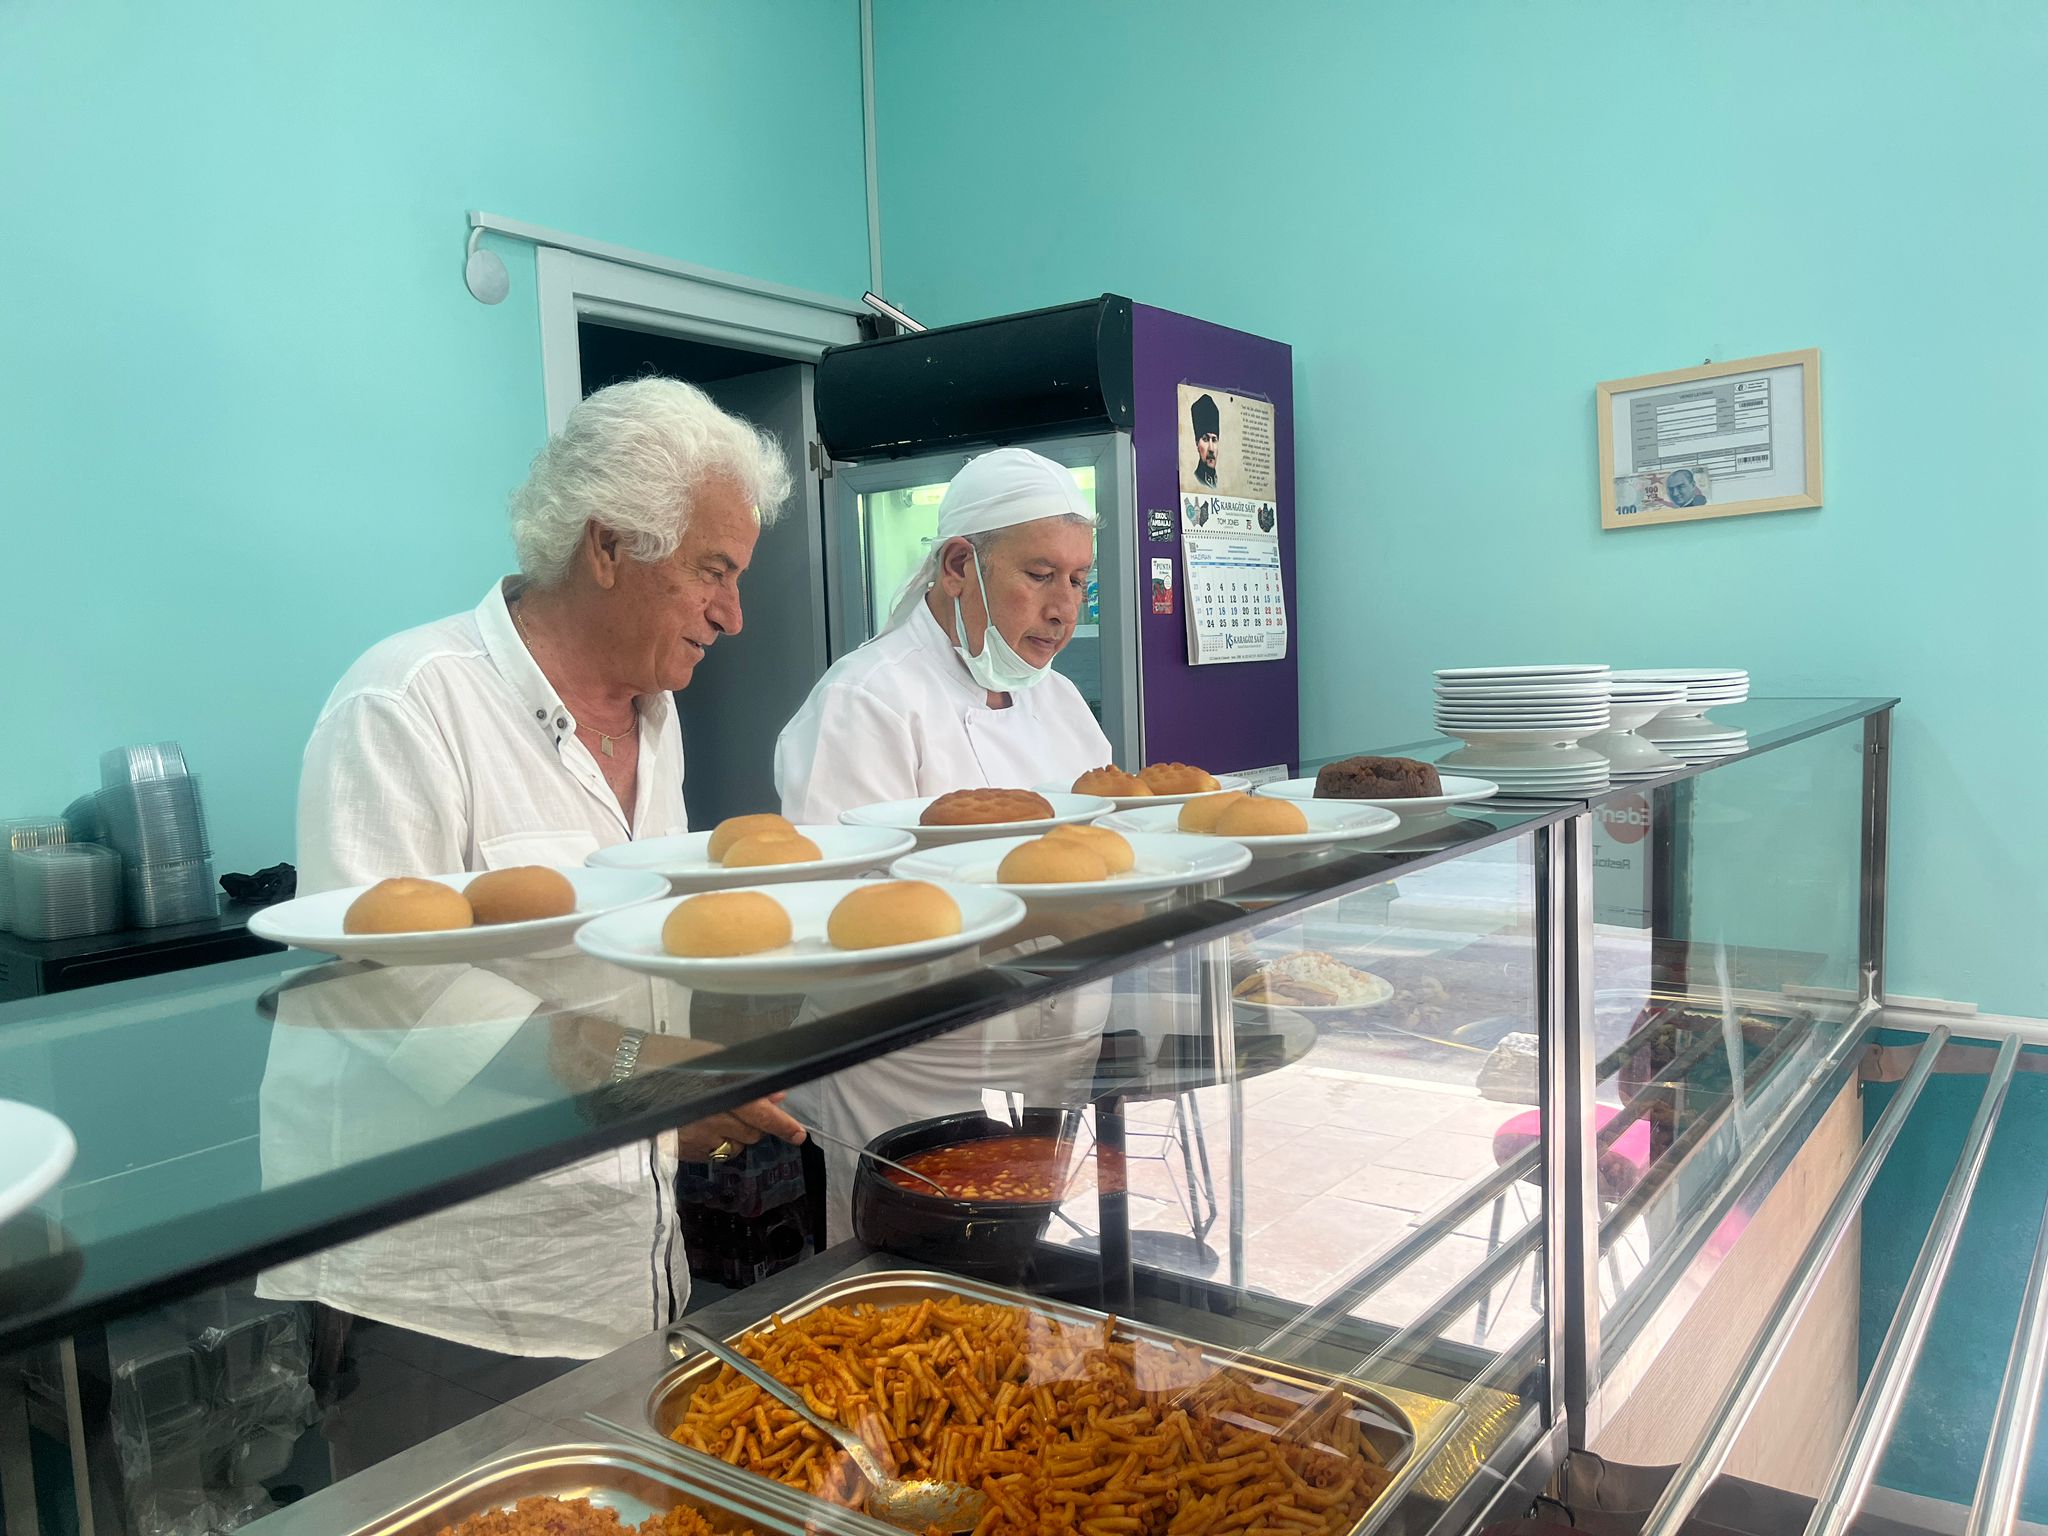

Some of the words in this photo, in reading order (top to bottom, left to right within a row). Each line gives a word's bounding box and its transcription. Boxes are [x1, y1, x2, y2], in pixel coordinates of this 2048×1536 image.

[1645, 486, 1658, 494] 100
[1221, 501, 1244, 512] KARAGÖZ
[1245, 503, 1256, 513] SAAT
[1616, 505, 1637, 515] 100
[1204, 595, 1212, 604] 10
[1218, 595, 1224, 603] 11
[1230, 595, 1236, 603] 12
[1242, 595, 1248, 603] 13
[1264, 595, 1270, 603] 15
[1206, 608, 1212, 616] 17
[1219, 607, 1226, 616] 18
[1231, 607, 1238, 616] 19
[1242, 607, 1250, 615] 20
[1254, 607, 1260, 615] 21
[1206, 620, 1214, 628] 24
[1220, 619, 1226, 628] 25
[1232, 619, 1238, 627] 26
[1254, 618, 1262, 626] 28
[1266, 618, 1272, 626] 29
[1276, 618, 1282, 626] 30
[1234, 634, 1254, 644] KARAGÖZ
